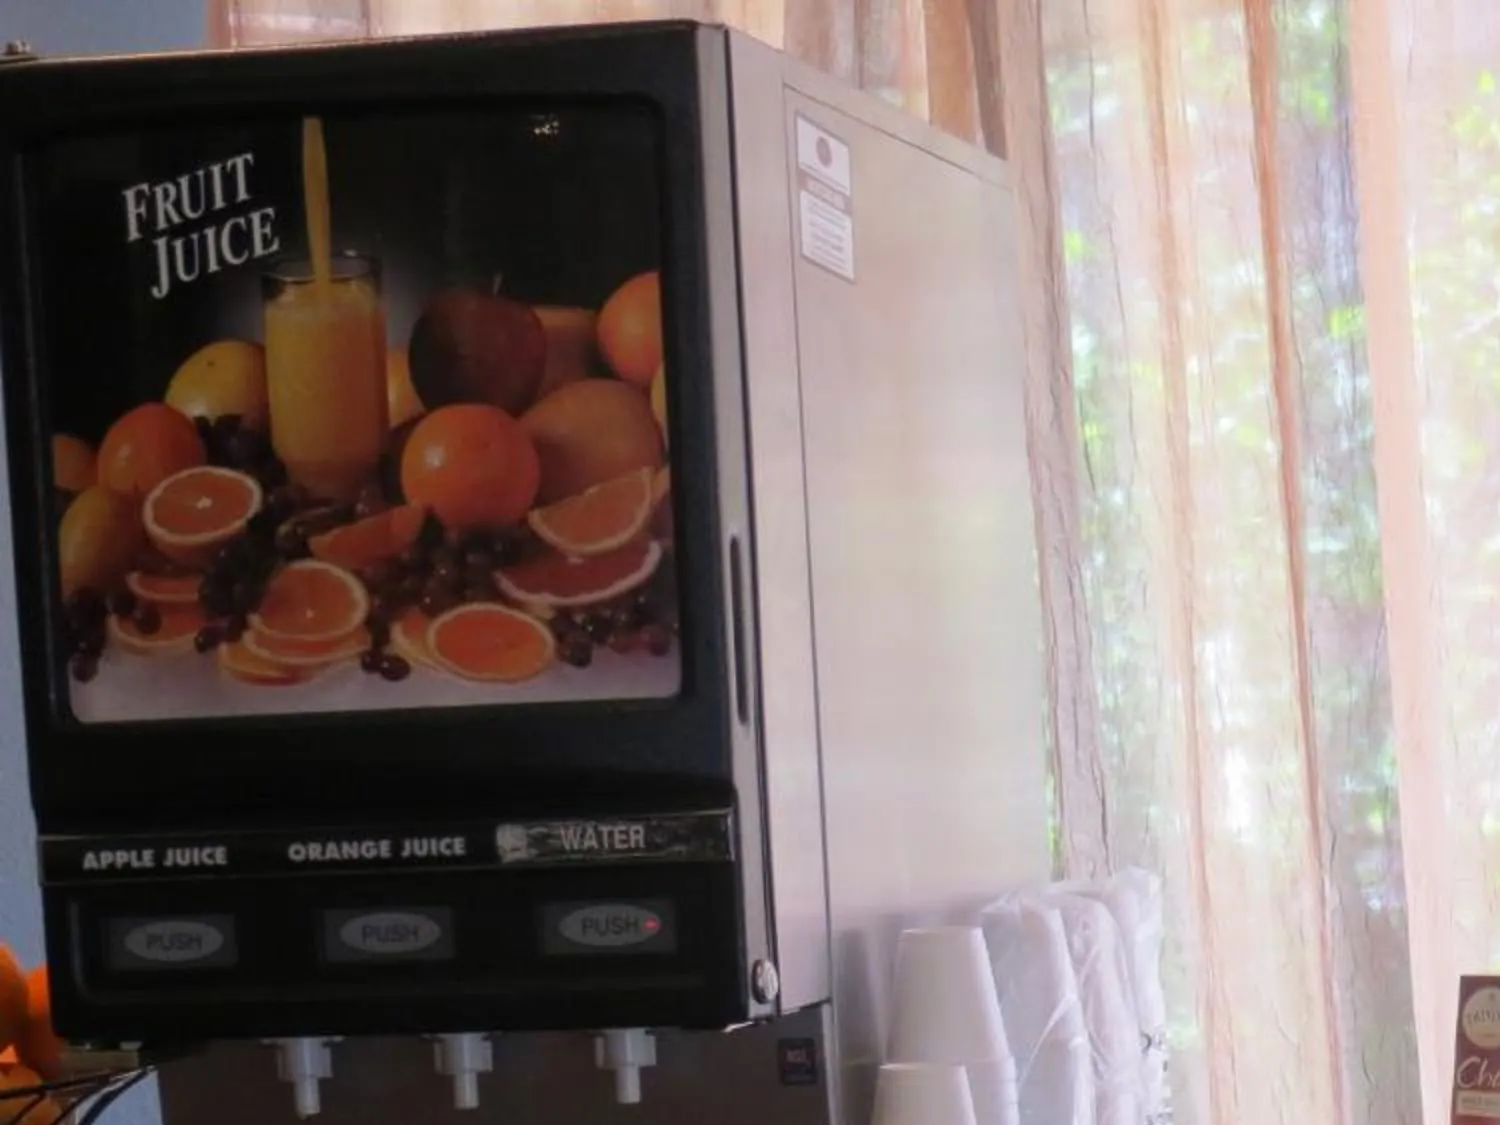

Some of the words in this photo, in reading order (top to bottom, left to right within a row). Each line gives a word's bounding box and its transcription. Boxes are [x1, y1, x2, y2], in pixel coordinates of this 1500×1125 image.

[122, 152, 254, 242] FRUIT
[151, 207, 280, 299] JUICE
[288, 839, 392, 861] ORANGE
[401, 836, 466, 857] JUICE
[559, 823, 645, 850] WATER
[83, 848, 155, 870] APPLE
[163, 845, 228, 867] JUICE
[361, 923, 419, 944] PUSH
[580, 916, 639, 936] PUSH
[146, 931, 202, 952] PUSH
